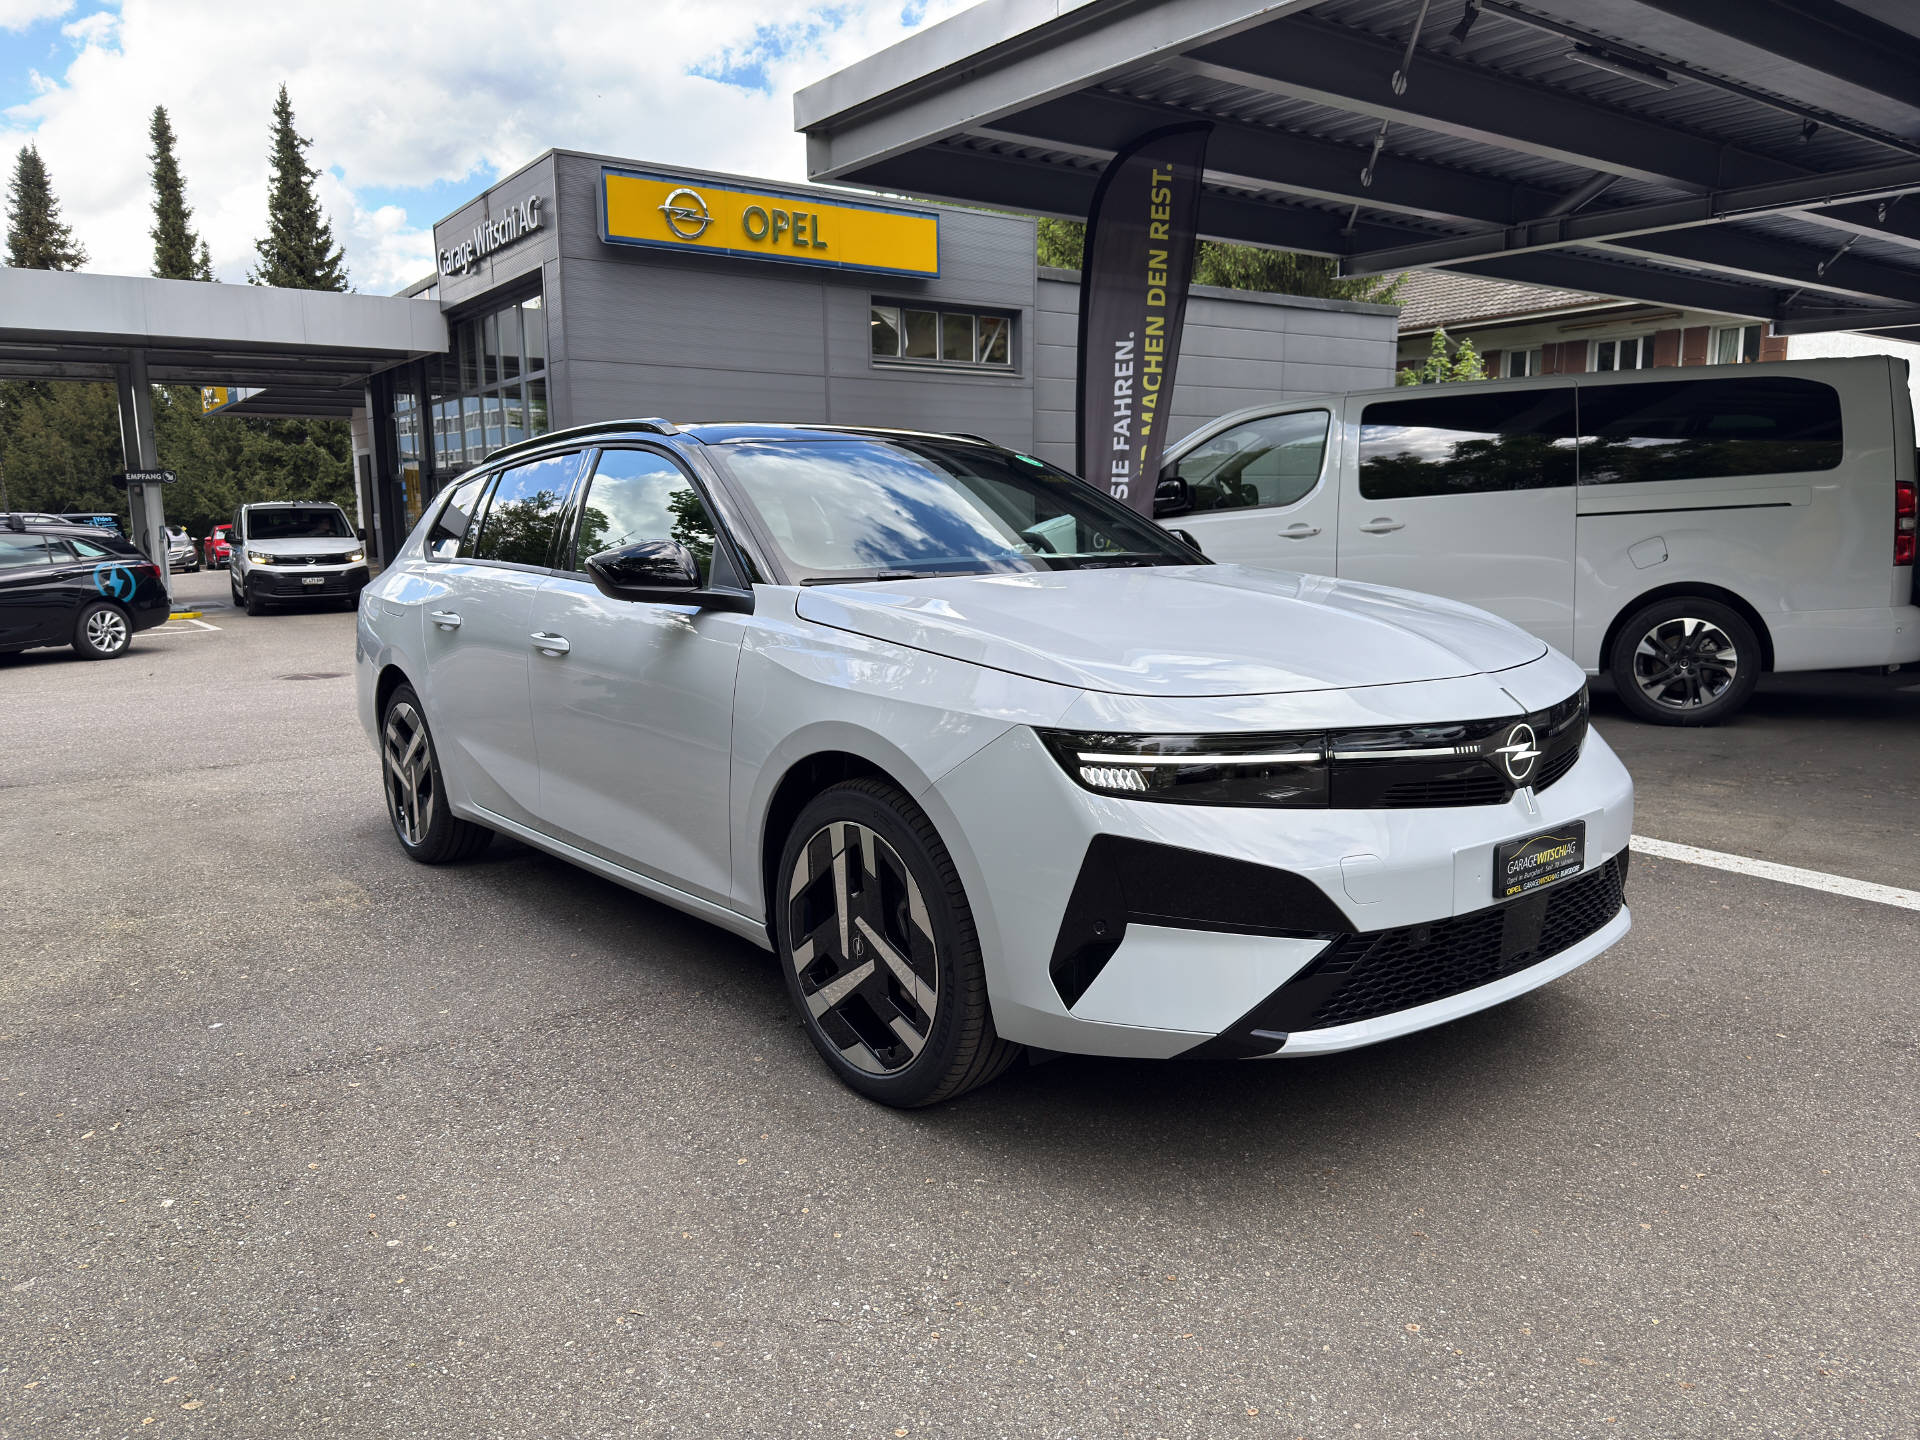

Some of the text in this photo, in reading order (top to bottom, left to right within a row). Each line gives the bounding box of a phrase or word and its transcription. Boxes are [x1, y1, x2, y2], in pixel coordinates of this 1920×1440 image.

[742, 205, 828, 249] OPEL
[1150, 163, 1173, 240] REST.
[438, 195, 541, 276] Garage Witschi AG
[1146, 249, 1168, 307] DEN
[1110, 331, 1135, 500] SIE FAHREN.
[1506, 885, 1521, 895] OPEL
